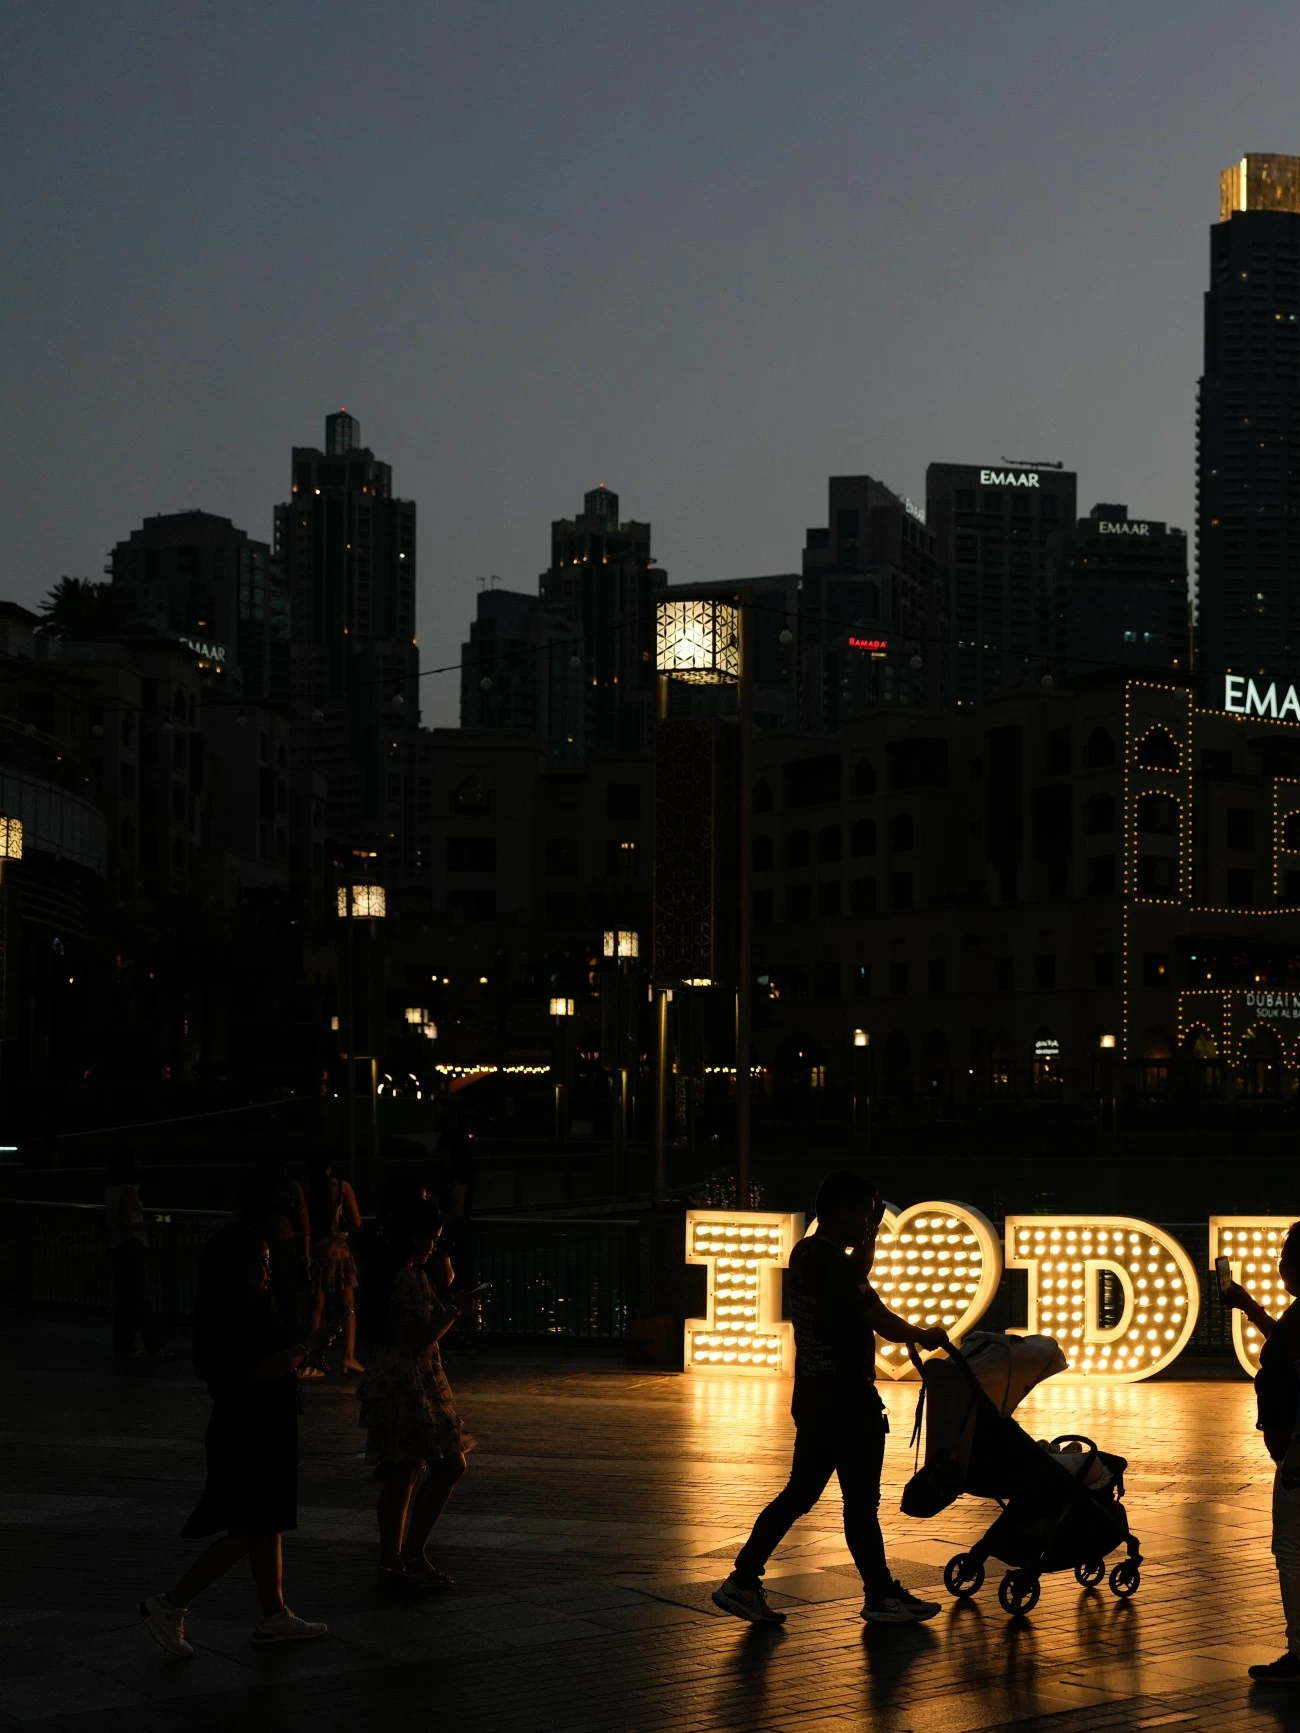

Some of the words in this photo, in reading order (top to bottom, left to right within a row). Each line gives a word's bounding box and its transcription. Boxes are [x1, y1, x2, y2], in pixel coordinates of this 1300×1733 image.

[980, 470, 1040, 488] EMAAR
[1099, 521, 1149, 535] EMAAR
[1246, 992, 1289, 1007] DUBAI
[1256, 1007, 1279, 1018] SOUK
[1281, 1009, 1291, 1018] AL
[684, 1210, 805, 1378] I
